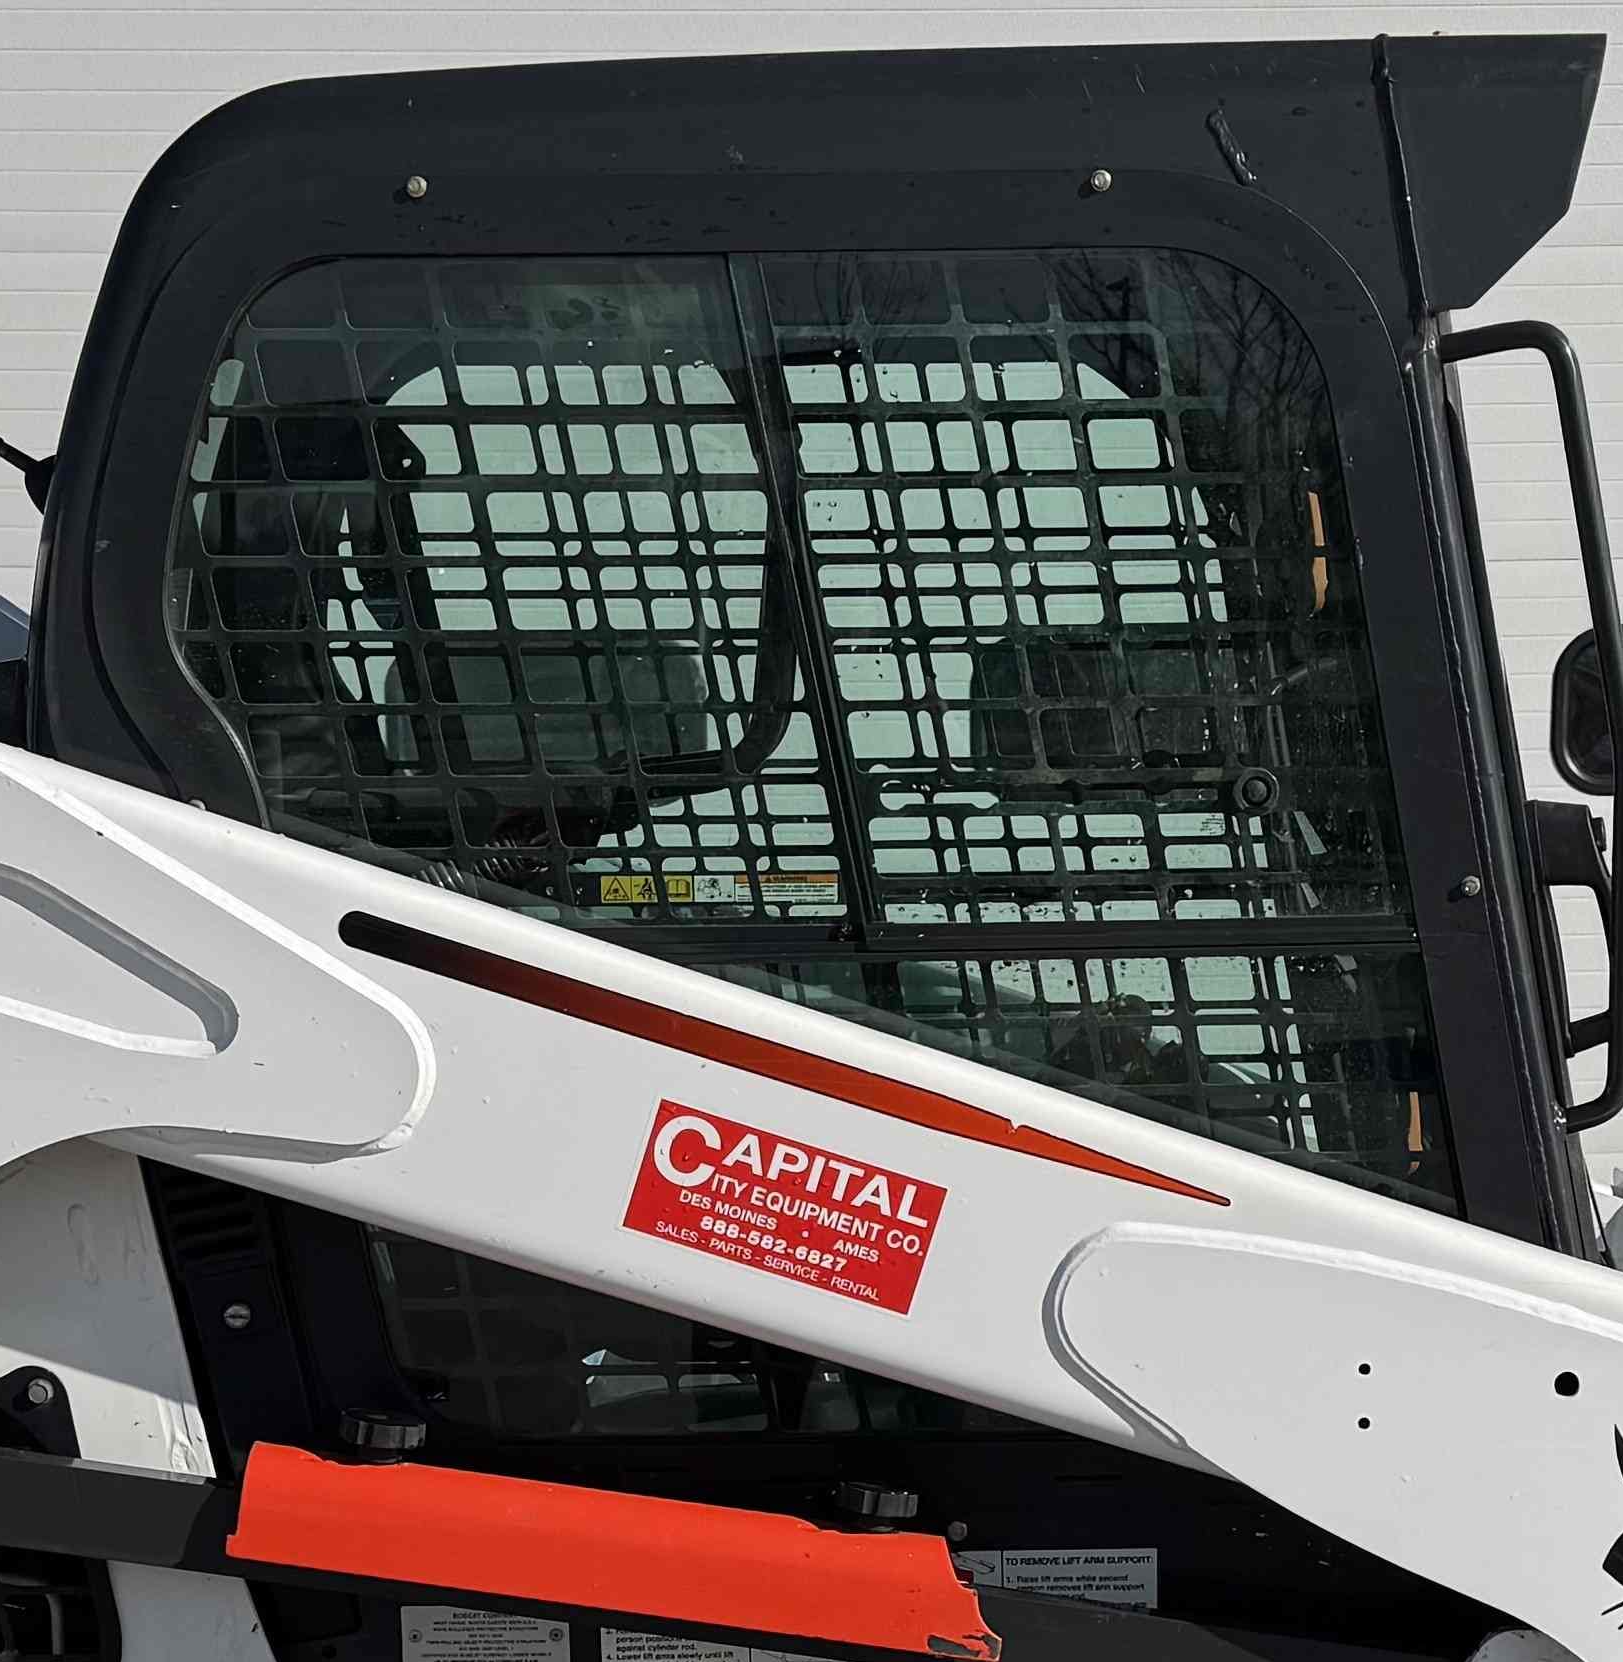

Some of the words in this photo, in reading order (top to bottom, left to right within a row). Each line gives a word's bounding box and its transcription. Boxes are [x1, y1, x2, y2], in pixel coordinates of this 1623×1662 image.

[653, 1114, 929, 1228] CAPITAL
[678, 1189, 713, 1212] DES
[713, 1198, 779, 1231] MOINES
[833, 1239, 880, 1263] AMES
[699, 1215, 849, 1272] 888-582-6827
[750, 1187, 884, 1243] EQUIPMENT
[886, 1229, 925, 1258] CO.
[655, 1220, 700, 1244] SALES
[708, 1236, 753, 1262] PARTS
[762, 1254, 821, 1283] SERVICE
[830, 1275, 880, 1301] RENTAL
